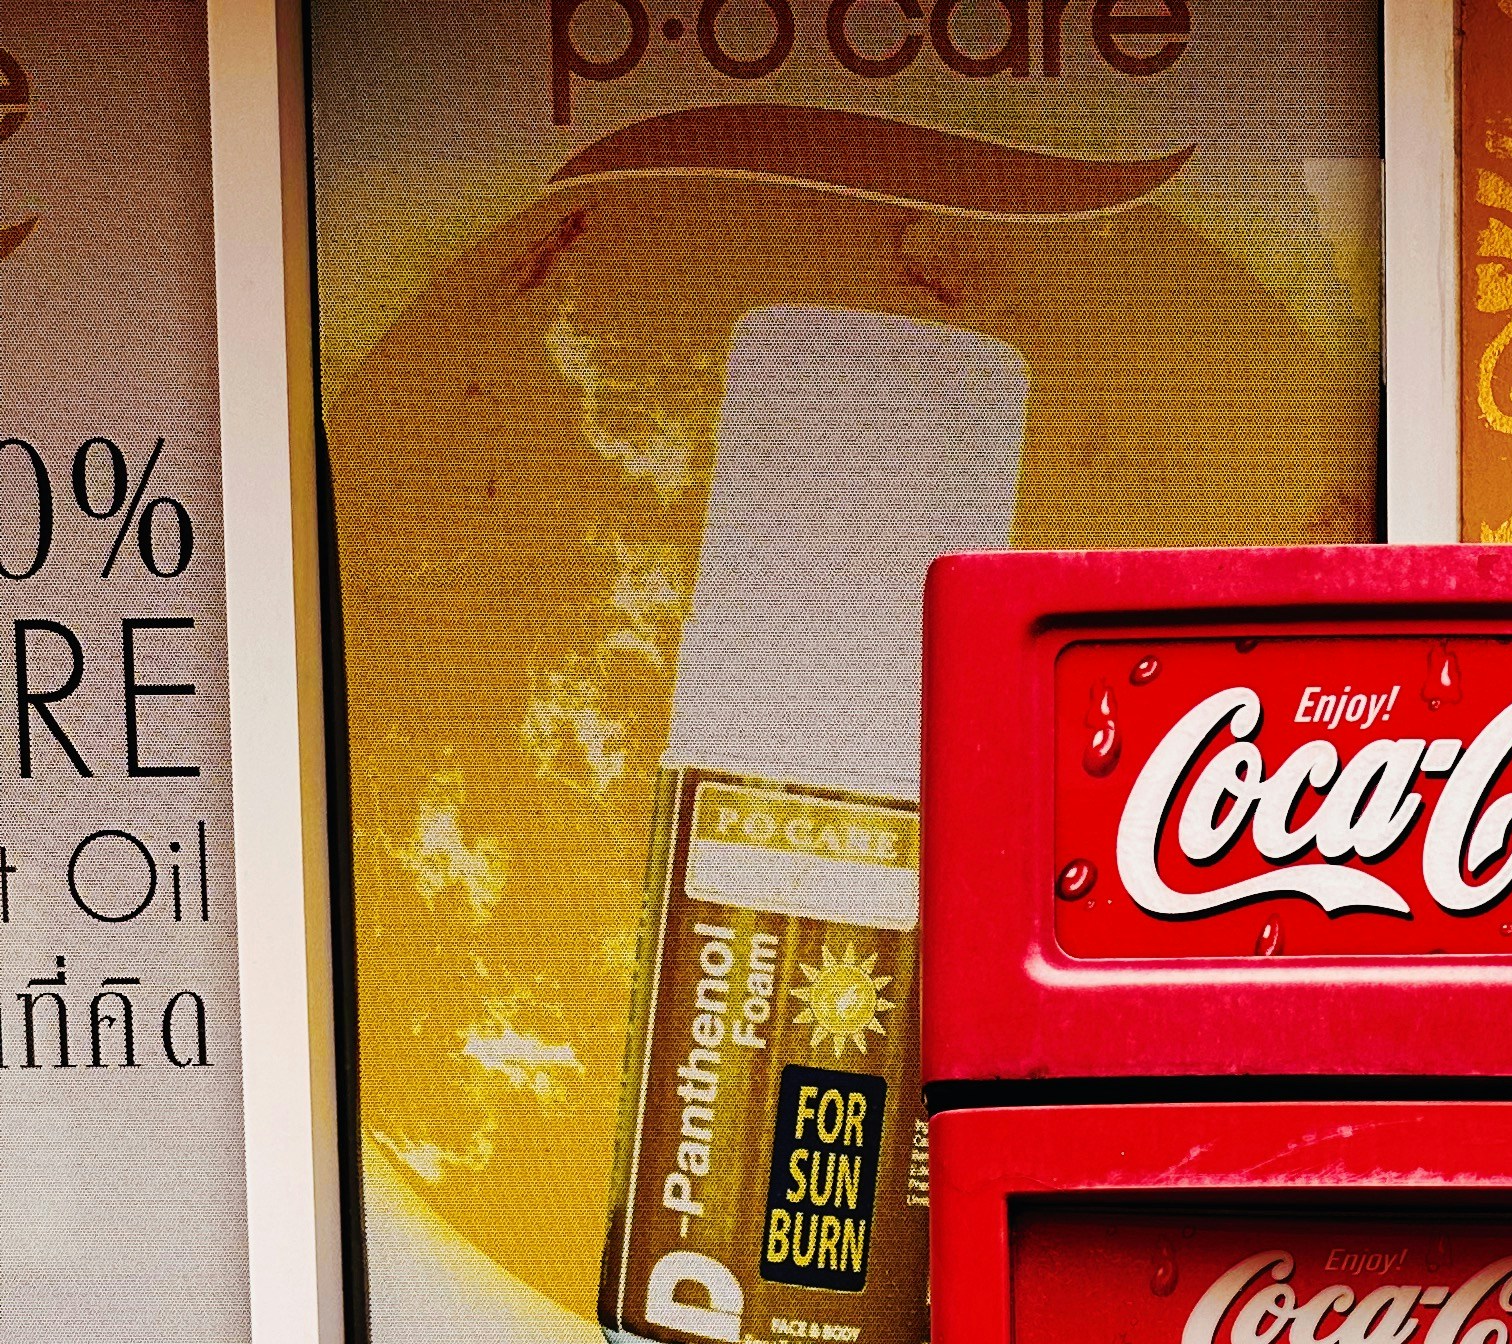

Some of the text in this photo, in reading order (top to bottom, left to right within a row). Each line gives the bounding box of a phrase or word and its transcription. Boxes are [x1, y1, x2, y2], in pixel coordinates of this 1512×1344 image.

[825, 0, 1191, 80] care
[13, 617, 202, 778] RE
[1293, 684, 1400, 730] Enjoy!
[67, 820, 210, 923] Oil
[0, 955, 215, 1069] ที่คิด
[731, 932, 780, 1050] Foam
[795, 1086, 867, 1147] FOR
[786, 1148, 862, 1210] SUN
[766, 1208, 866, 1273] BURN
[1324, 1246, 1409, 1276] Enjoy!
